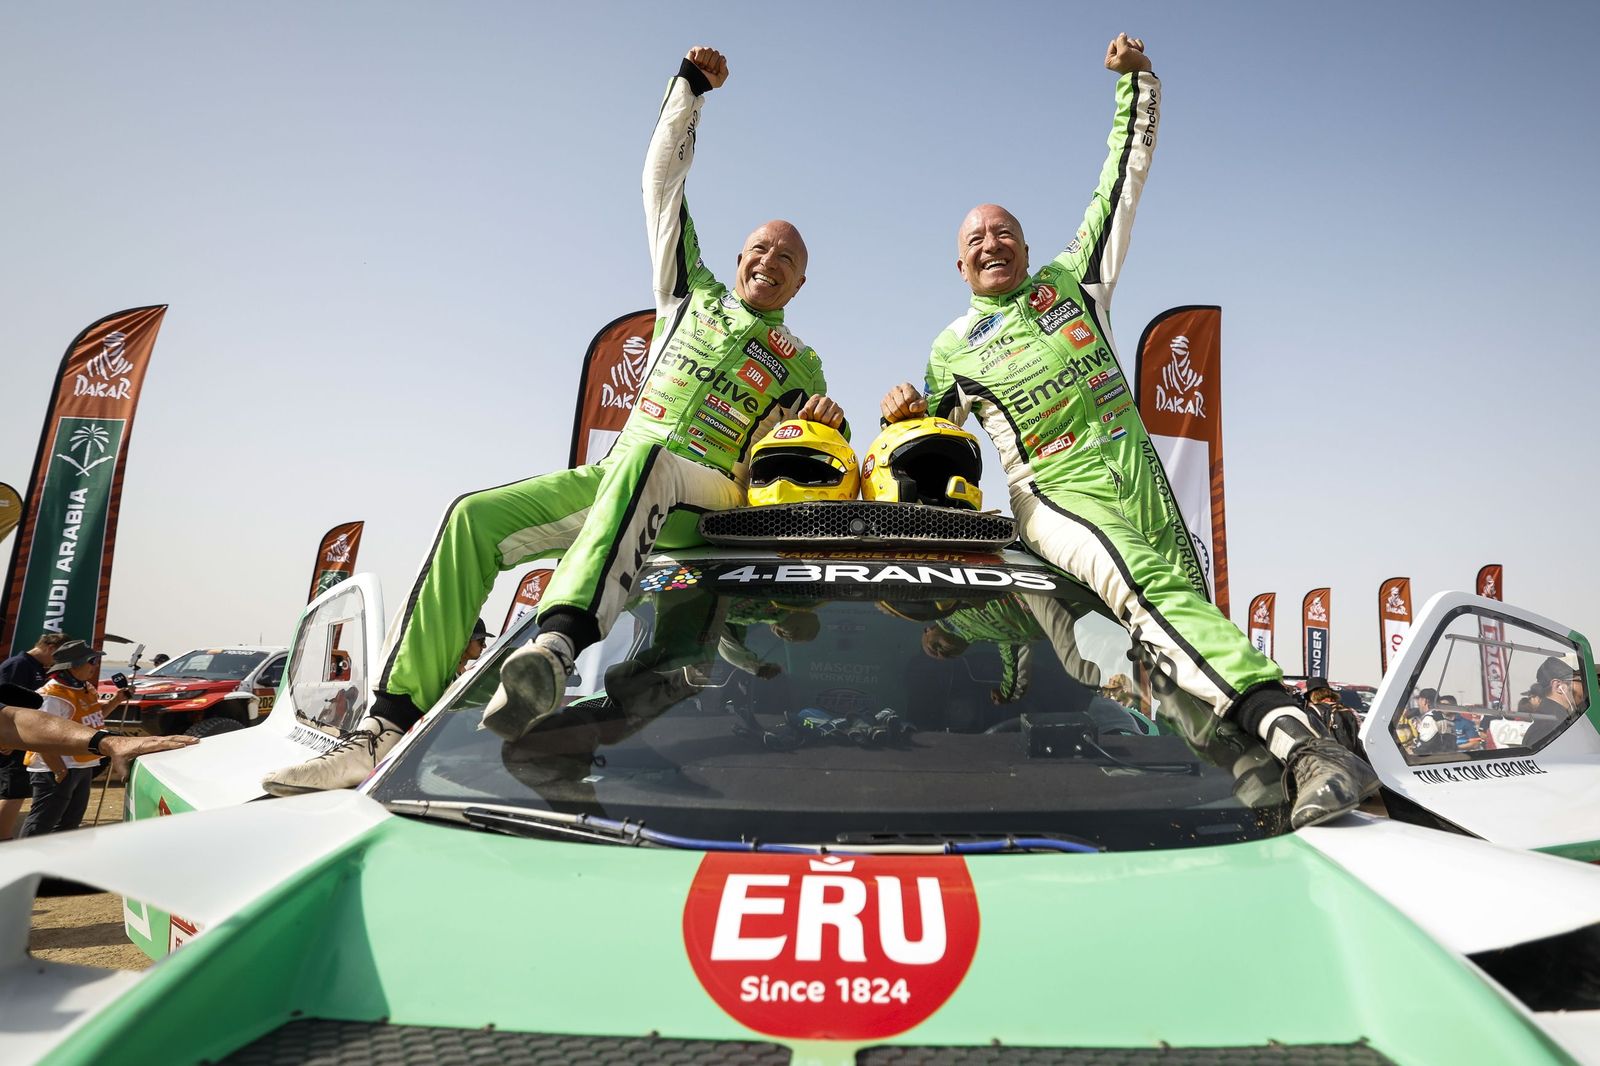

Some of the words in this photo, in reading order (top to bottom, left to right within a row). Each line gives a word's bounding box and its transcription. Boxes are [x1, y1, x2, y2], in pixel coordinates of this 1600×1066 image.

[1142, 88, 1157, 147] Emotive
[1044, 307, 1081, 333] WORKWEAR
[1070, 326, 1090, 341] JBL
[979, 332, 1015, 362] DHG
[746, 346, 783, 380] WORKWEAR
[980, 349, 1012, 375] KEUKEN
[73, 374, 131, 400] DAKAR
[661, 344, 759, 413] Emotive
[746, 366, 764, 388] JBL
[1008, 347, 1111, 414] Emotive
[601, 383, 635, 410] DAK
[1156, 384, 1206, 419] DAKAR
[705, 416, 738, 439] ROORDINK
[777, 429, 801, 438] ERU
[56, 487, 88, 572] ARABIA
[718, 565, 1057, 591] 4-BRANDS
[43, 579, 70, 633] AUDI
[1312, 630, 1322, 678] ENDER
[1413, 770, 1448, 785] TIM
[1453, 764, 1493, 782] TOM
[1486, 759, 1548, 778] CORONEL
[711, 873, 947, 965] ERU
[740, 975, 826, 1003] Since
[835, 977, 911, 1004] 1824
